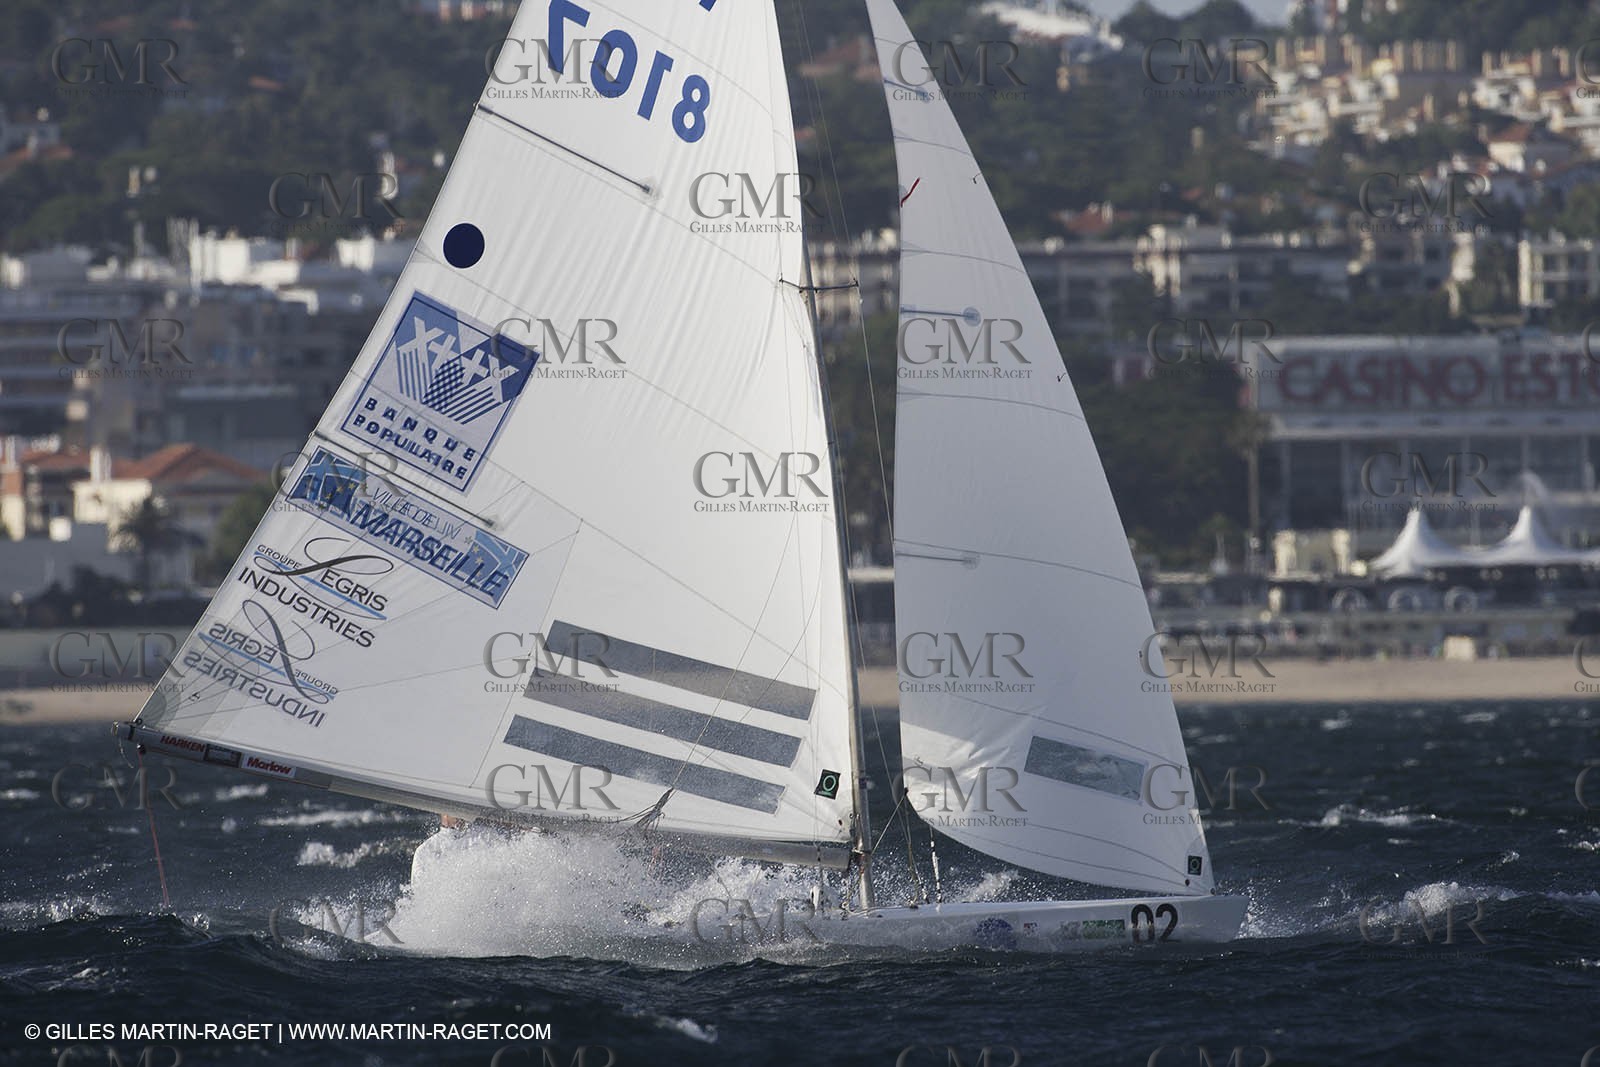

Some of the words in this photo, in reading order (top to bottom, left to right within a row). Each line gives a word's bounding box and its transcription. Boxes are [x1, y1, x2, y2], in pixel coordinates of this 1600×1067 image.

[1278, 354, 1487, 403] CASINO
[1503, 352, 1600, 402] EST
[364, 397, 476, 461] BANQUE
[257, 544, 302, 569] GROUPE
[350, 503, 509, 597] MARSEILLE
[238, 567, 375, 648] INDUSTRIES
[160, 735, 205, 753] HARKEN
[247, 756, 291, 775] Marlow
[1131, 903, 1179, 944] 02
